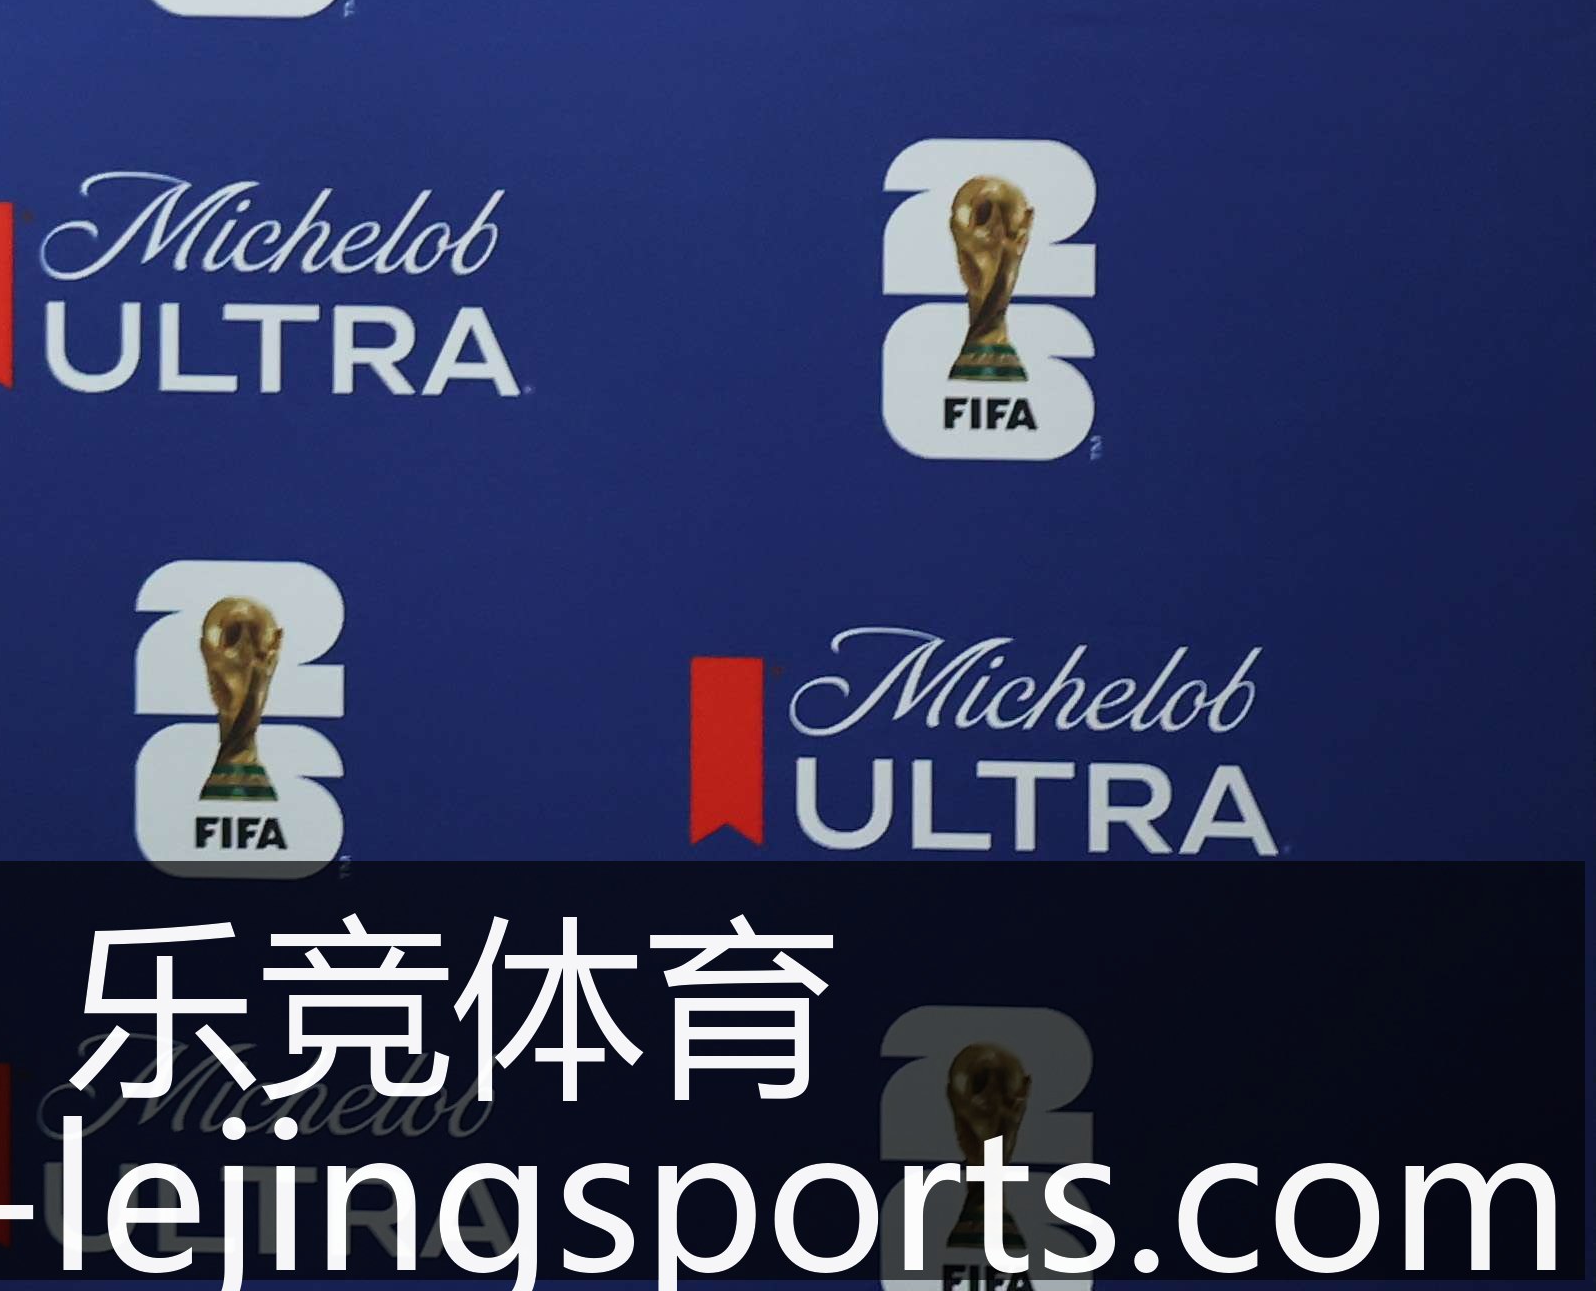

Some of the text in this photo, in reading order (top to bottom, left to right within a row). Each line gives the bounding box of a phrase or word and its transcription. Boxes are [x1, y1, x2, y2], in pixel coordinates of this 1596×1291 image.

[41, 172, 504, 280] Michelob
[46, 301, 520, 396] ULTRA
[945, 398, 1037, 430] FIFA
[790, 627, 1262, 736] Michelob
[196, 817, 286, 849] FIFA
[796, 757, 1278, 856] ULTRA
